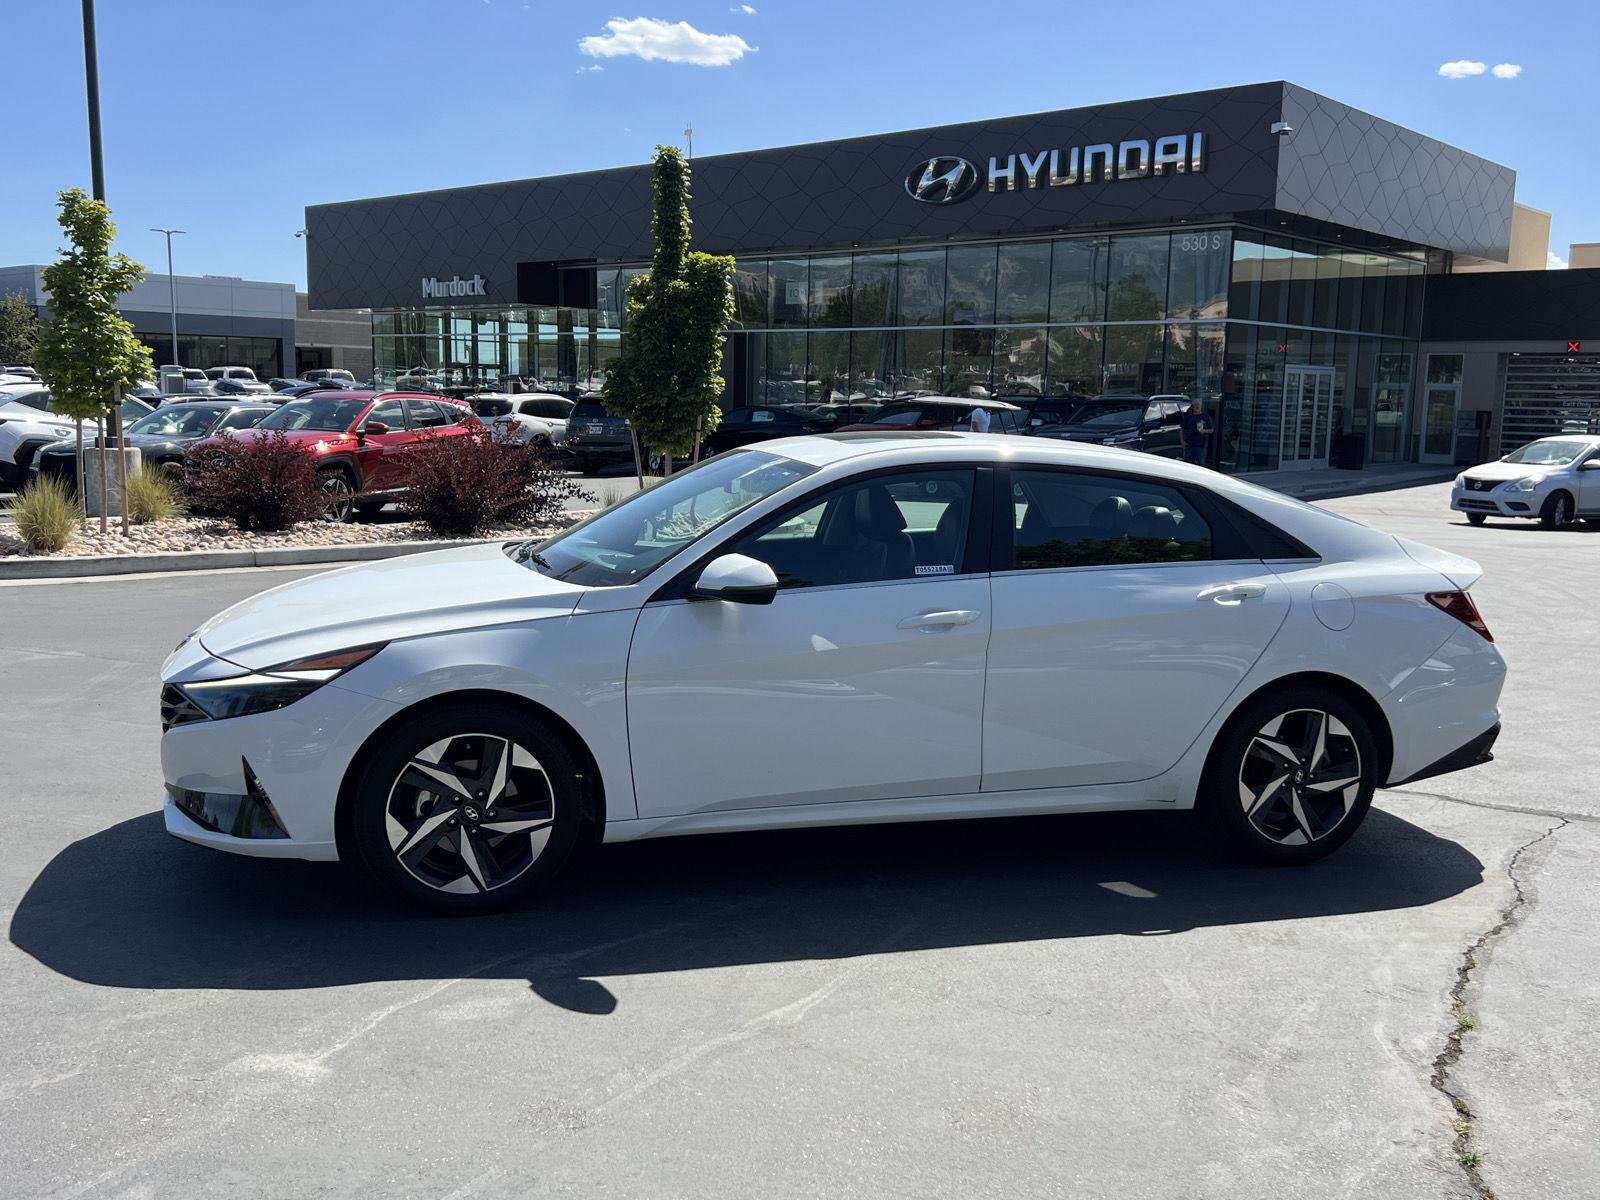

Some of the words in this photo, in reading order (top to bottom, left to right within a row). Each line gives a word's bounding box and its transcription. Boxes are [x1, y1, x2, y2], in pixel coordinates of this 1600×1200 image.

[988, 132, 1207, 192] HYUNDAI
[1182, 236, 1208, 251] 530
[1212, 235, 1221, 250] S
[422, 274, 486, 298] Murdock
